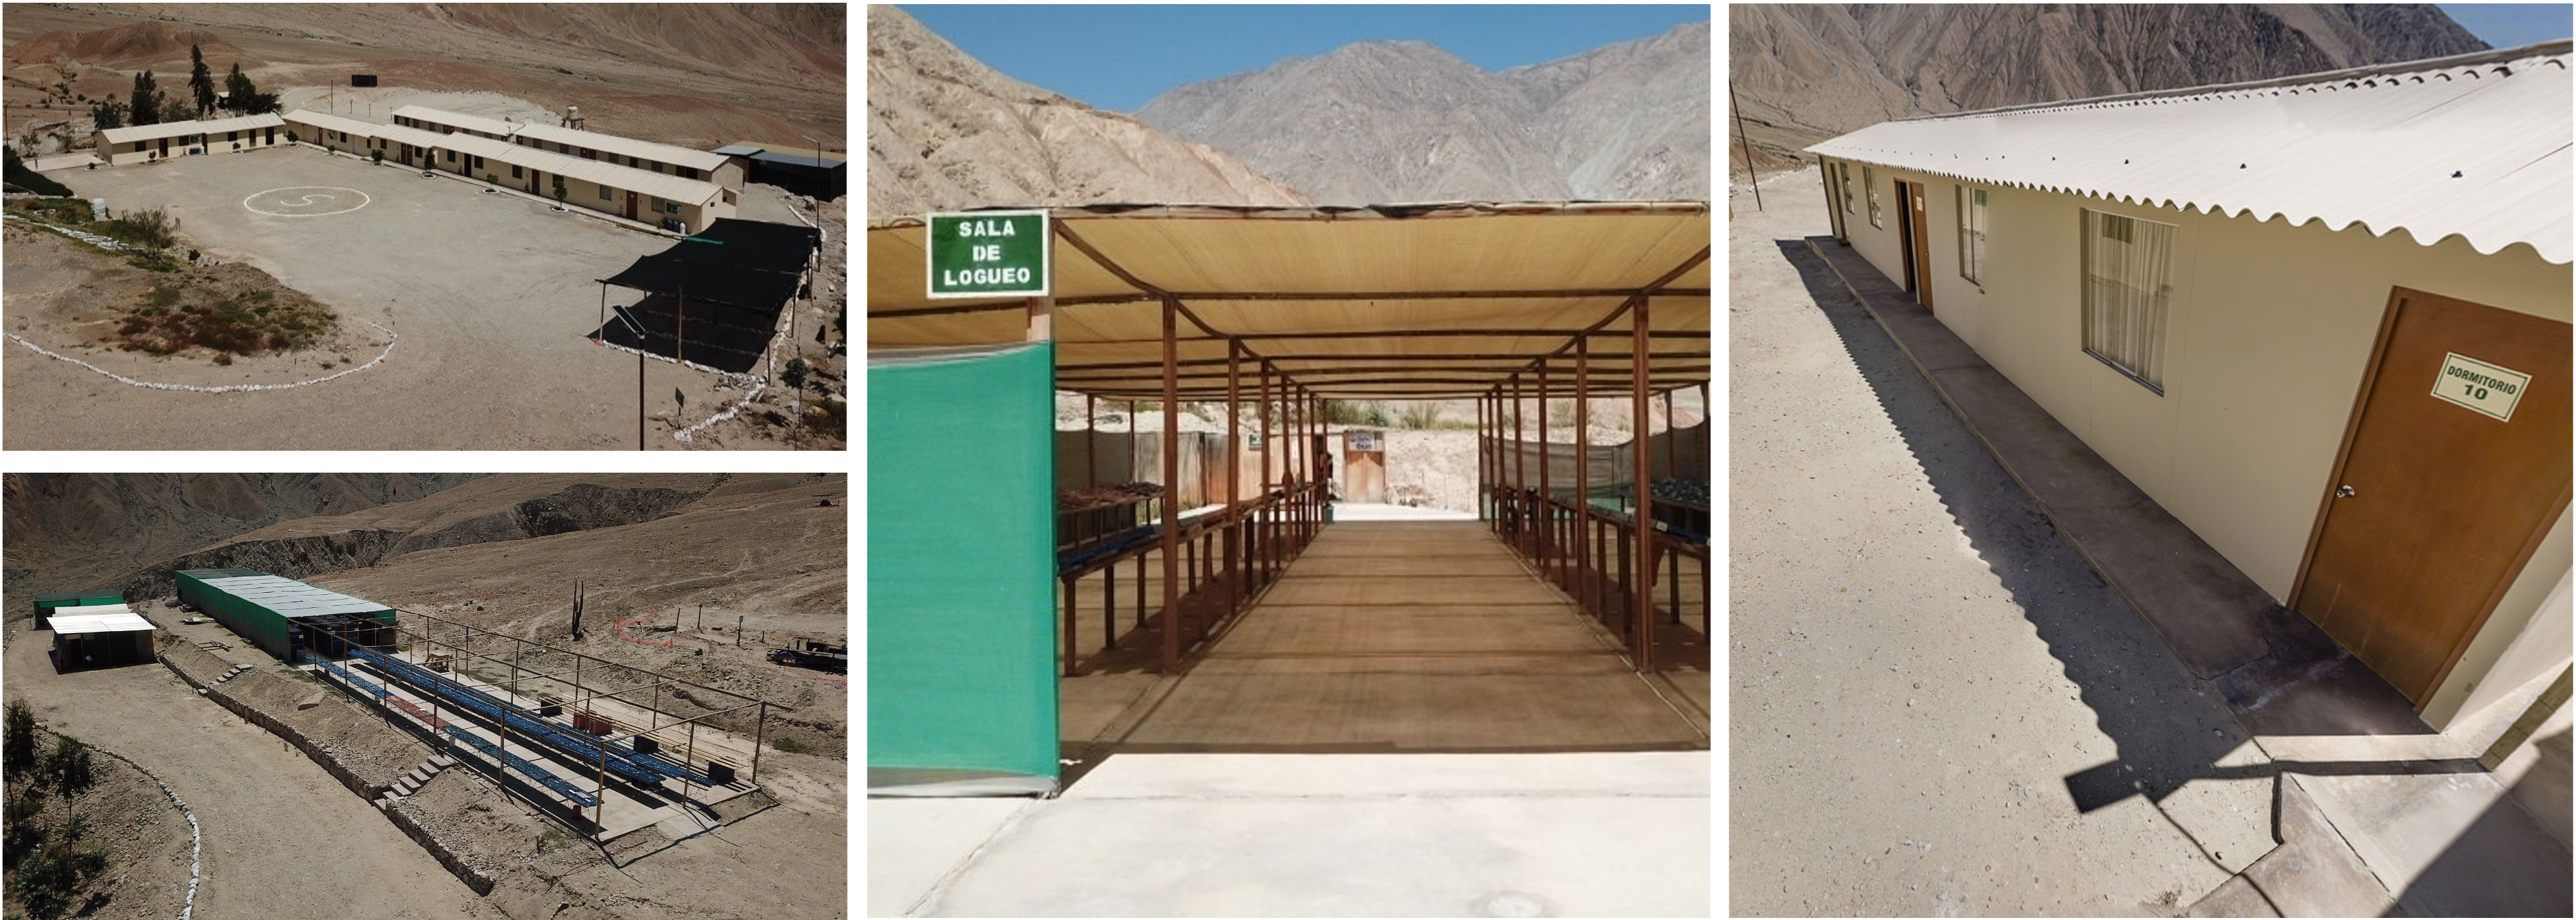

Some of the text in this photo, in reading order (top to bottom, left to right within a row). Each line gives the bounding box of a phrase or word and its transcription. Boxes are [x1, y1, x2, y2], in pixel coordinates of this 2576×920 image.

[959, 219, 1016, 237] SALA
[972, 245, 1001, 262] DE
[944, 267, 1031, 286] LOGUEO
[2447, 365, 2517, 395] DORMITORIO
[2465, 385, 2489, 400] 10
